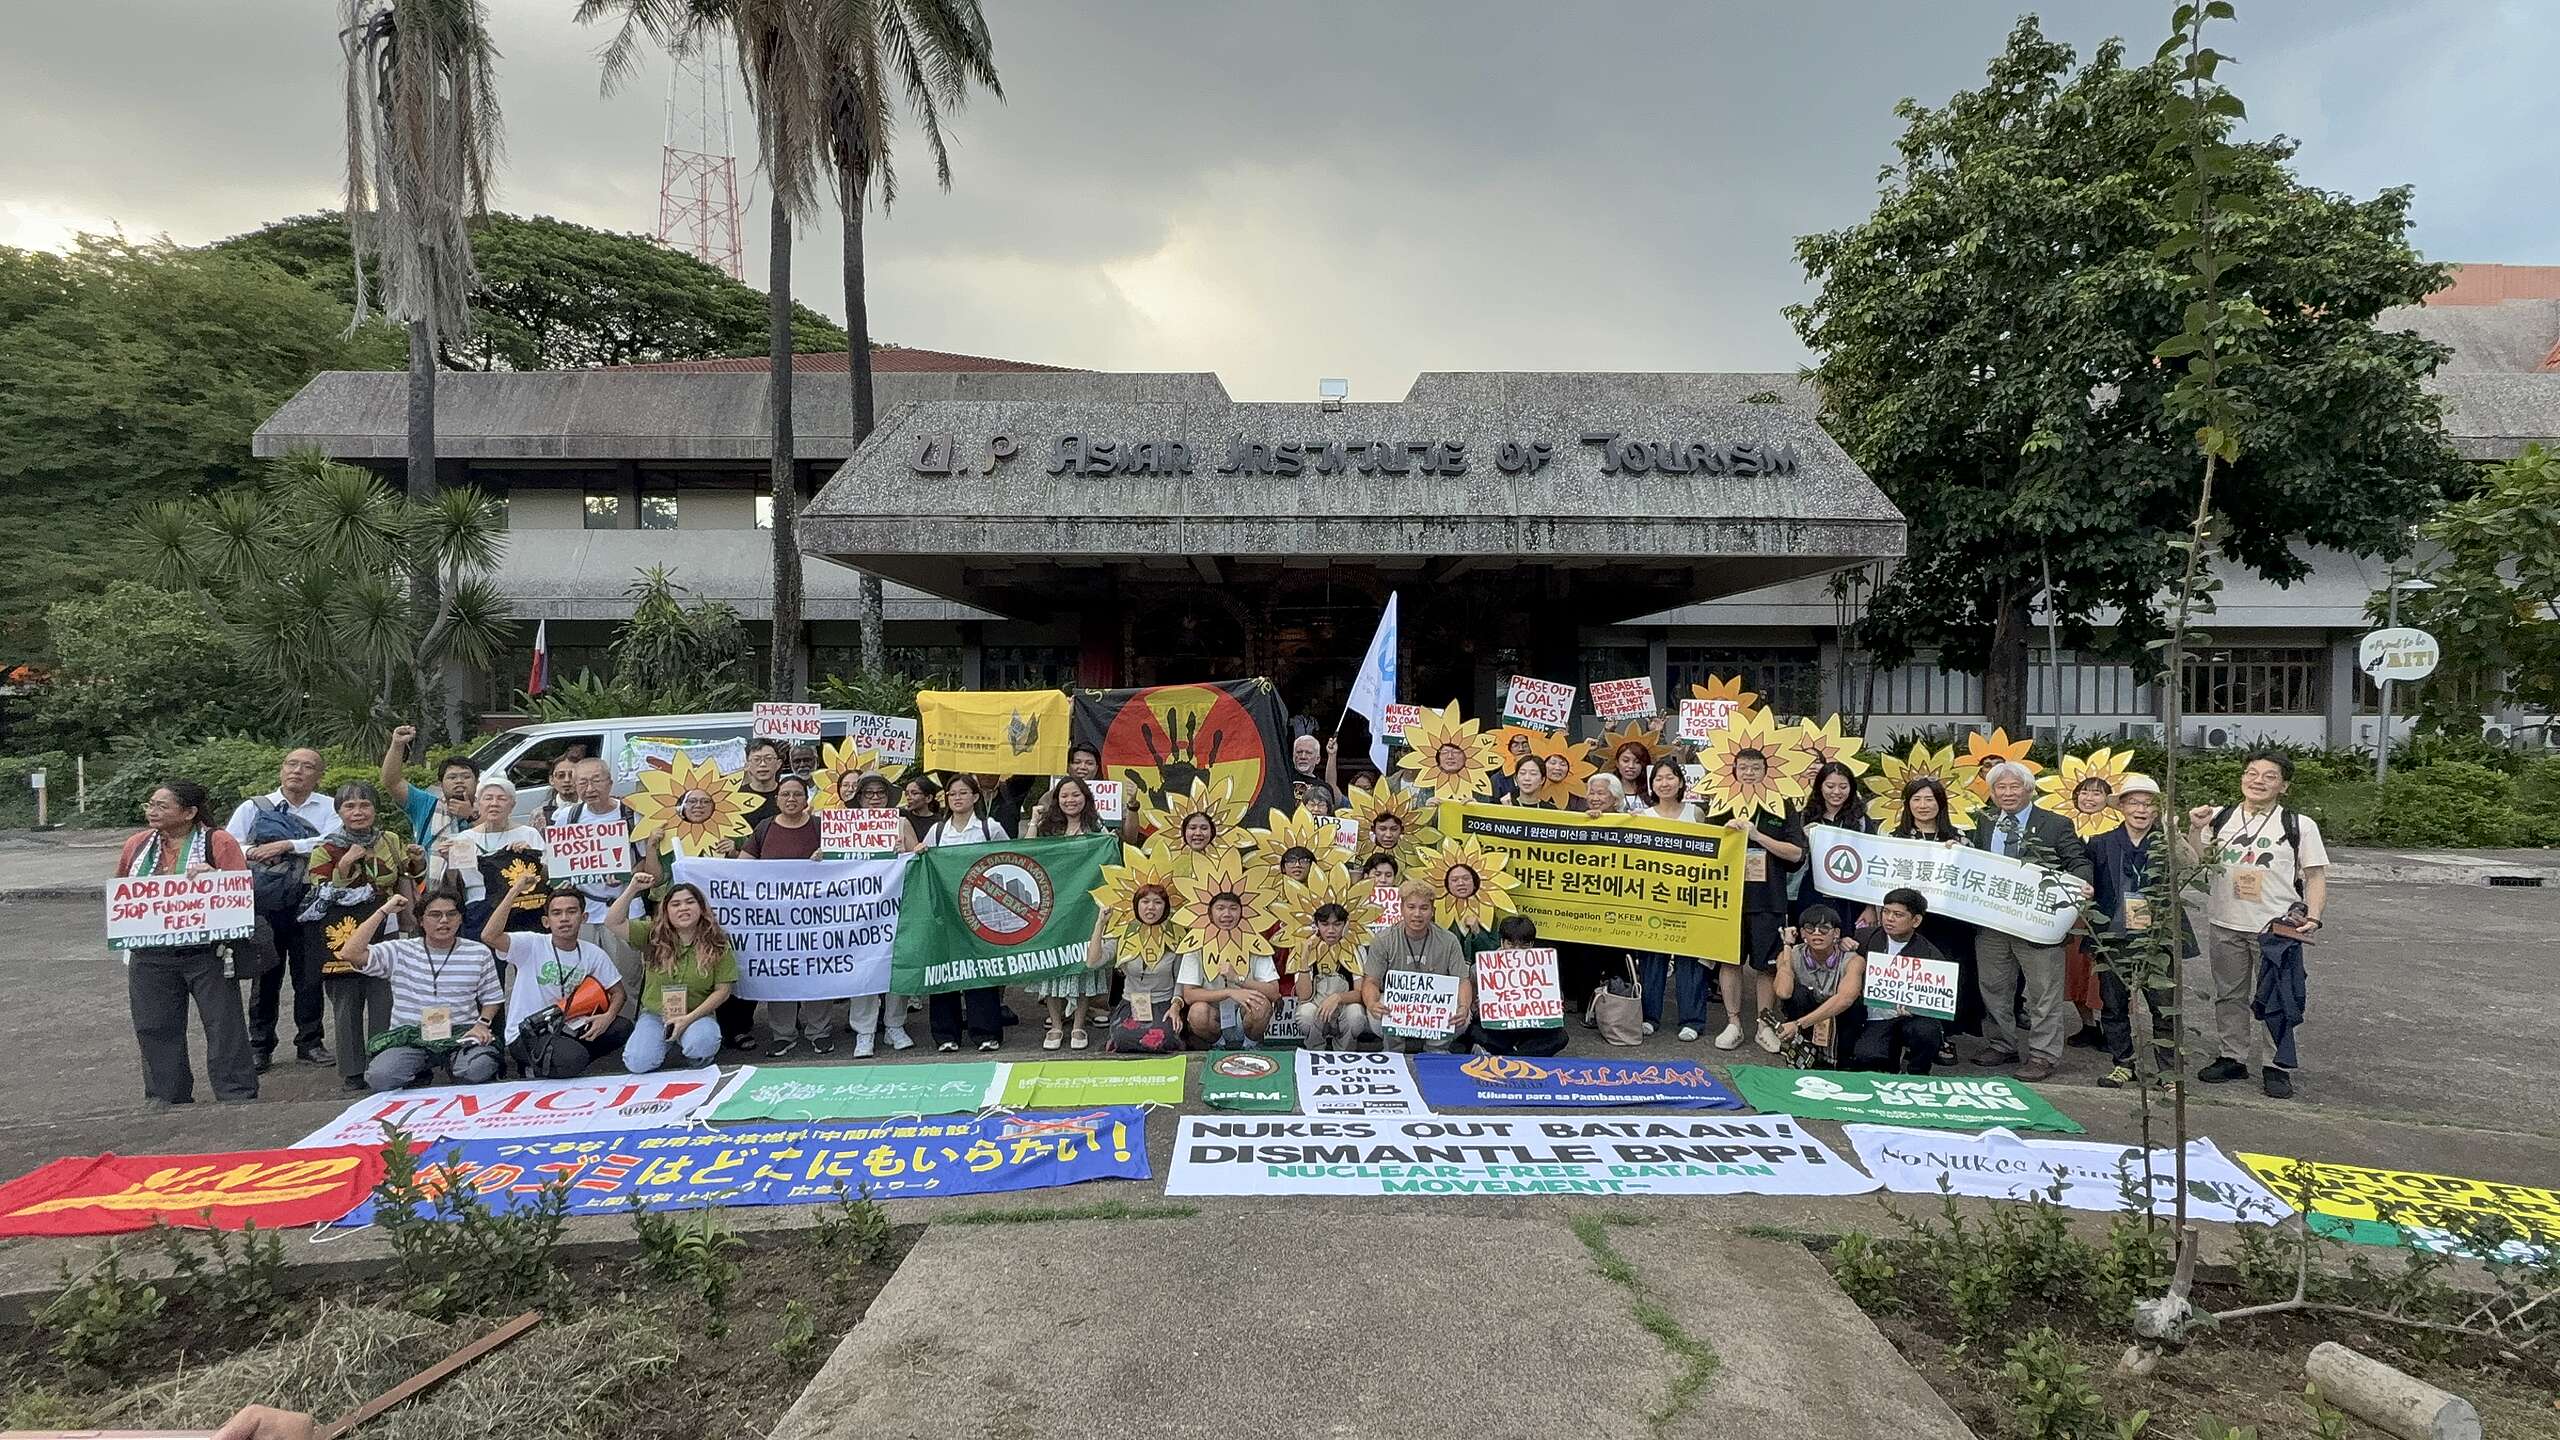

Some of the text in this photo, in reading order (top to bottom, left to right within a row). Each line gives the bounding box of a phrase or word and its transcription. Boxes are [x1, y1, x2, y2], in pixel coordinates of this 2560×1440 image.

[983, 434, 1019, 476] P
[1512, 677, 1573, 697] PHASE OUT
[1591, 680, 1643, 695] RENEWABLE
[1637, 688, 1651, 696] THE
[1515, 690, 1553, 707] COAL
[1595, 696, 1644, 710] PEOPLE NOT
[756, 704, 817, 716] PHASE OUT
[1386, 704, 1412, 716] NUKES
[1513, 704, 1566, 723] NUKES!
[1681, 701, 1715, 717] PHASE
[791, 719, 821, 736] NUKES
[853, 716, 911, 740] PHASE OUT COAL
[1387, 725, 1402, 733] YES
[1399, 716, 1420, 725] COAL
[1686, 718, 1726, 727] FOSSIL
[853, 736, 873, 749] ES
[1096, 784, 1118, 794] OUT
[822, 809, 897, 821] NUCLEAR POWER
[547, 822, 625, 843] PHASE OUT
[823, 822, 853, 834] PLANT
[1468, 821, 1492, 832] 2026
[1494, 824, 1522, 835] NNAF
[1530, 827, 1557, 839] 원전의
[1560, 830, 1588, 841] 미신을
[1623, 833, 1652, 845] 생명과
[1654, 837, 1683, 849] 안전의
[1685, 840, 1714, 852] 미래로
[553, 839, 608, 857] FOSSIL
[1527, 847, 1729, 882] Nuclear! Lansagin!
[114, 876, 256, 900] ADB DO NO HARM
[710, 876, 882, 900] REAL CLIMATE ACTION
[1514, 867, 1729, 910] 바탄 원전에서 손 떼라!
[1867, 855, 2057, 916] 台灣環境保護聯盟
[111, 902, 148, 921] STOP
[153, 898, 205, 915] FUNDING
[745, 907, 785, 926] REAL
[1522, 905, 1553, 916] Korean
[1554, 909, 1601, 921] Delegation
[1617, 913, 1643, 922] KFEM
[1971, 895, 2022, 920] Protection
[2024, 913, 2055, 928] Union
[164, 912, 207, 930] FUELS!
[1555, 920, 1602, 934] Philippines
[1610, 928, 1632, 938] June
[755, 924, 894, 951] THE LINE ON ADB'S
[749, 954, 854, 977] FALSE FIXES
[1008, 948, 1058, 975] BATAAN
[1479, 949, 1553, 970] NUKES OUT
[1890, 956, 1922, 971] ADB
[1386, 973, 1434, 991] NUCLEAR
[1481, 969, 1553, 990] NO COAL
[1868, 965, 1945, 986] DO NO HARM
[1496, 987, 1542, 1002] YES TO
[1875, 978, 1954, 998] STOP FUNDING
[1867, 986, 1954, 1011] FOSSILS FUEL!
[1481, 1000, 1564, 1019] RENEWABLE!
[1310, 1052, 1390, 1065] NGO
[1311, 1066, 1396, 1076] Forum
[1313, 1084, 1402, 1096] ADB
[1477, 1091, 1522, 1100] Kilusan
[1526, 1092, 1552, 1102] para
[1870, 1080, 2013, 1097] YOUNG
[1878, 1092, 2031, 1111] BEAN
[475, 1109, 596, 1124] Movement
[1192, 1122, 1794, 1139] NUKES OUT BATAAN!
[1189, 1144, 1828, 1165] DISMANTLE BNPP!
[1267, 1164, 1776, 1178] NUCLEAR-FREE BATAAN
[2315, 1166, 2475, 1193] STOP
